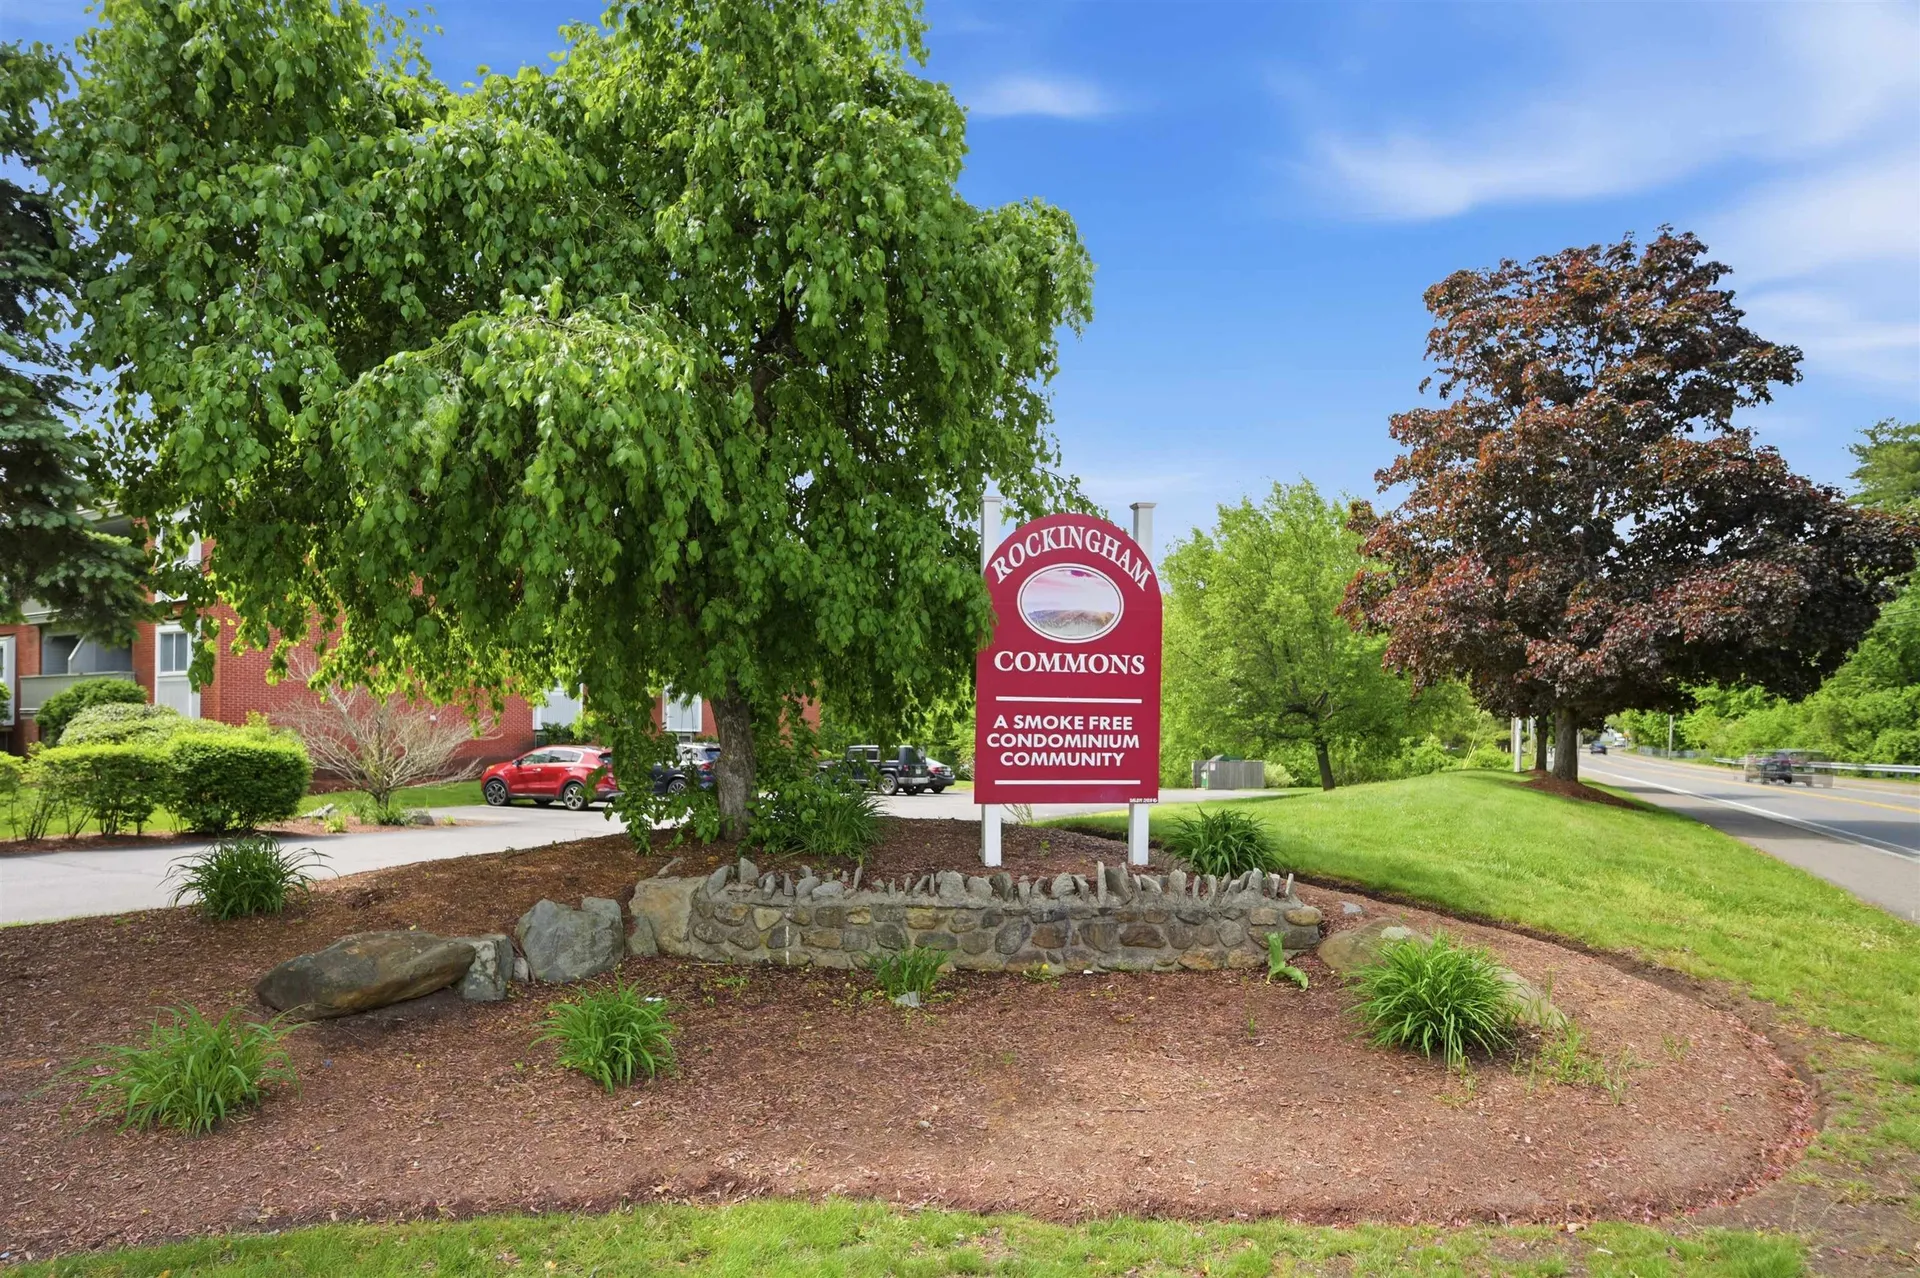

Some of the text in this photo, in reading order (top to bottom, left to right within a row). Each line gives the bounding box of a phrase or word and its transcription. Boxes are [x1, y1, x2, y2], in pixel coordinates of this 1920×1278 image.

[992, 525, 1152, 592] ROCKINGHAM
[994, 651, 1145, 675] COMMONS
[993, 714, 1133, 730] A SMOKE FREE
[986, 733, 1140, 749] CONDOMINIUM
[1000, 752, 1125, 767] COMMUNITY
